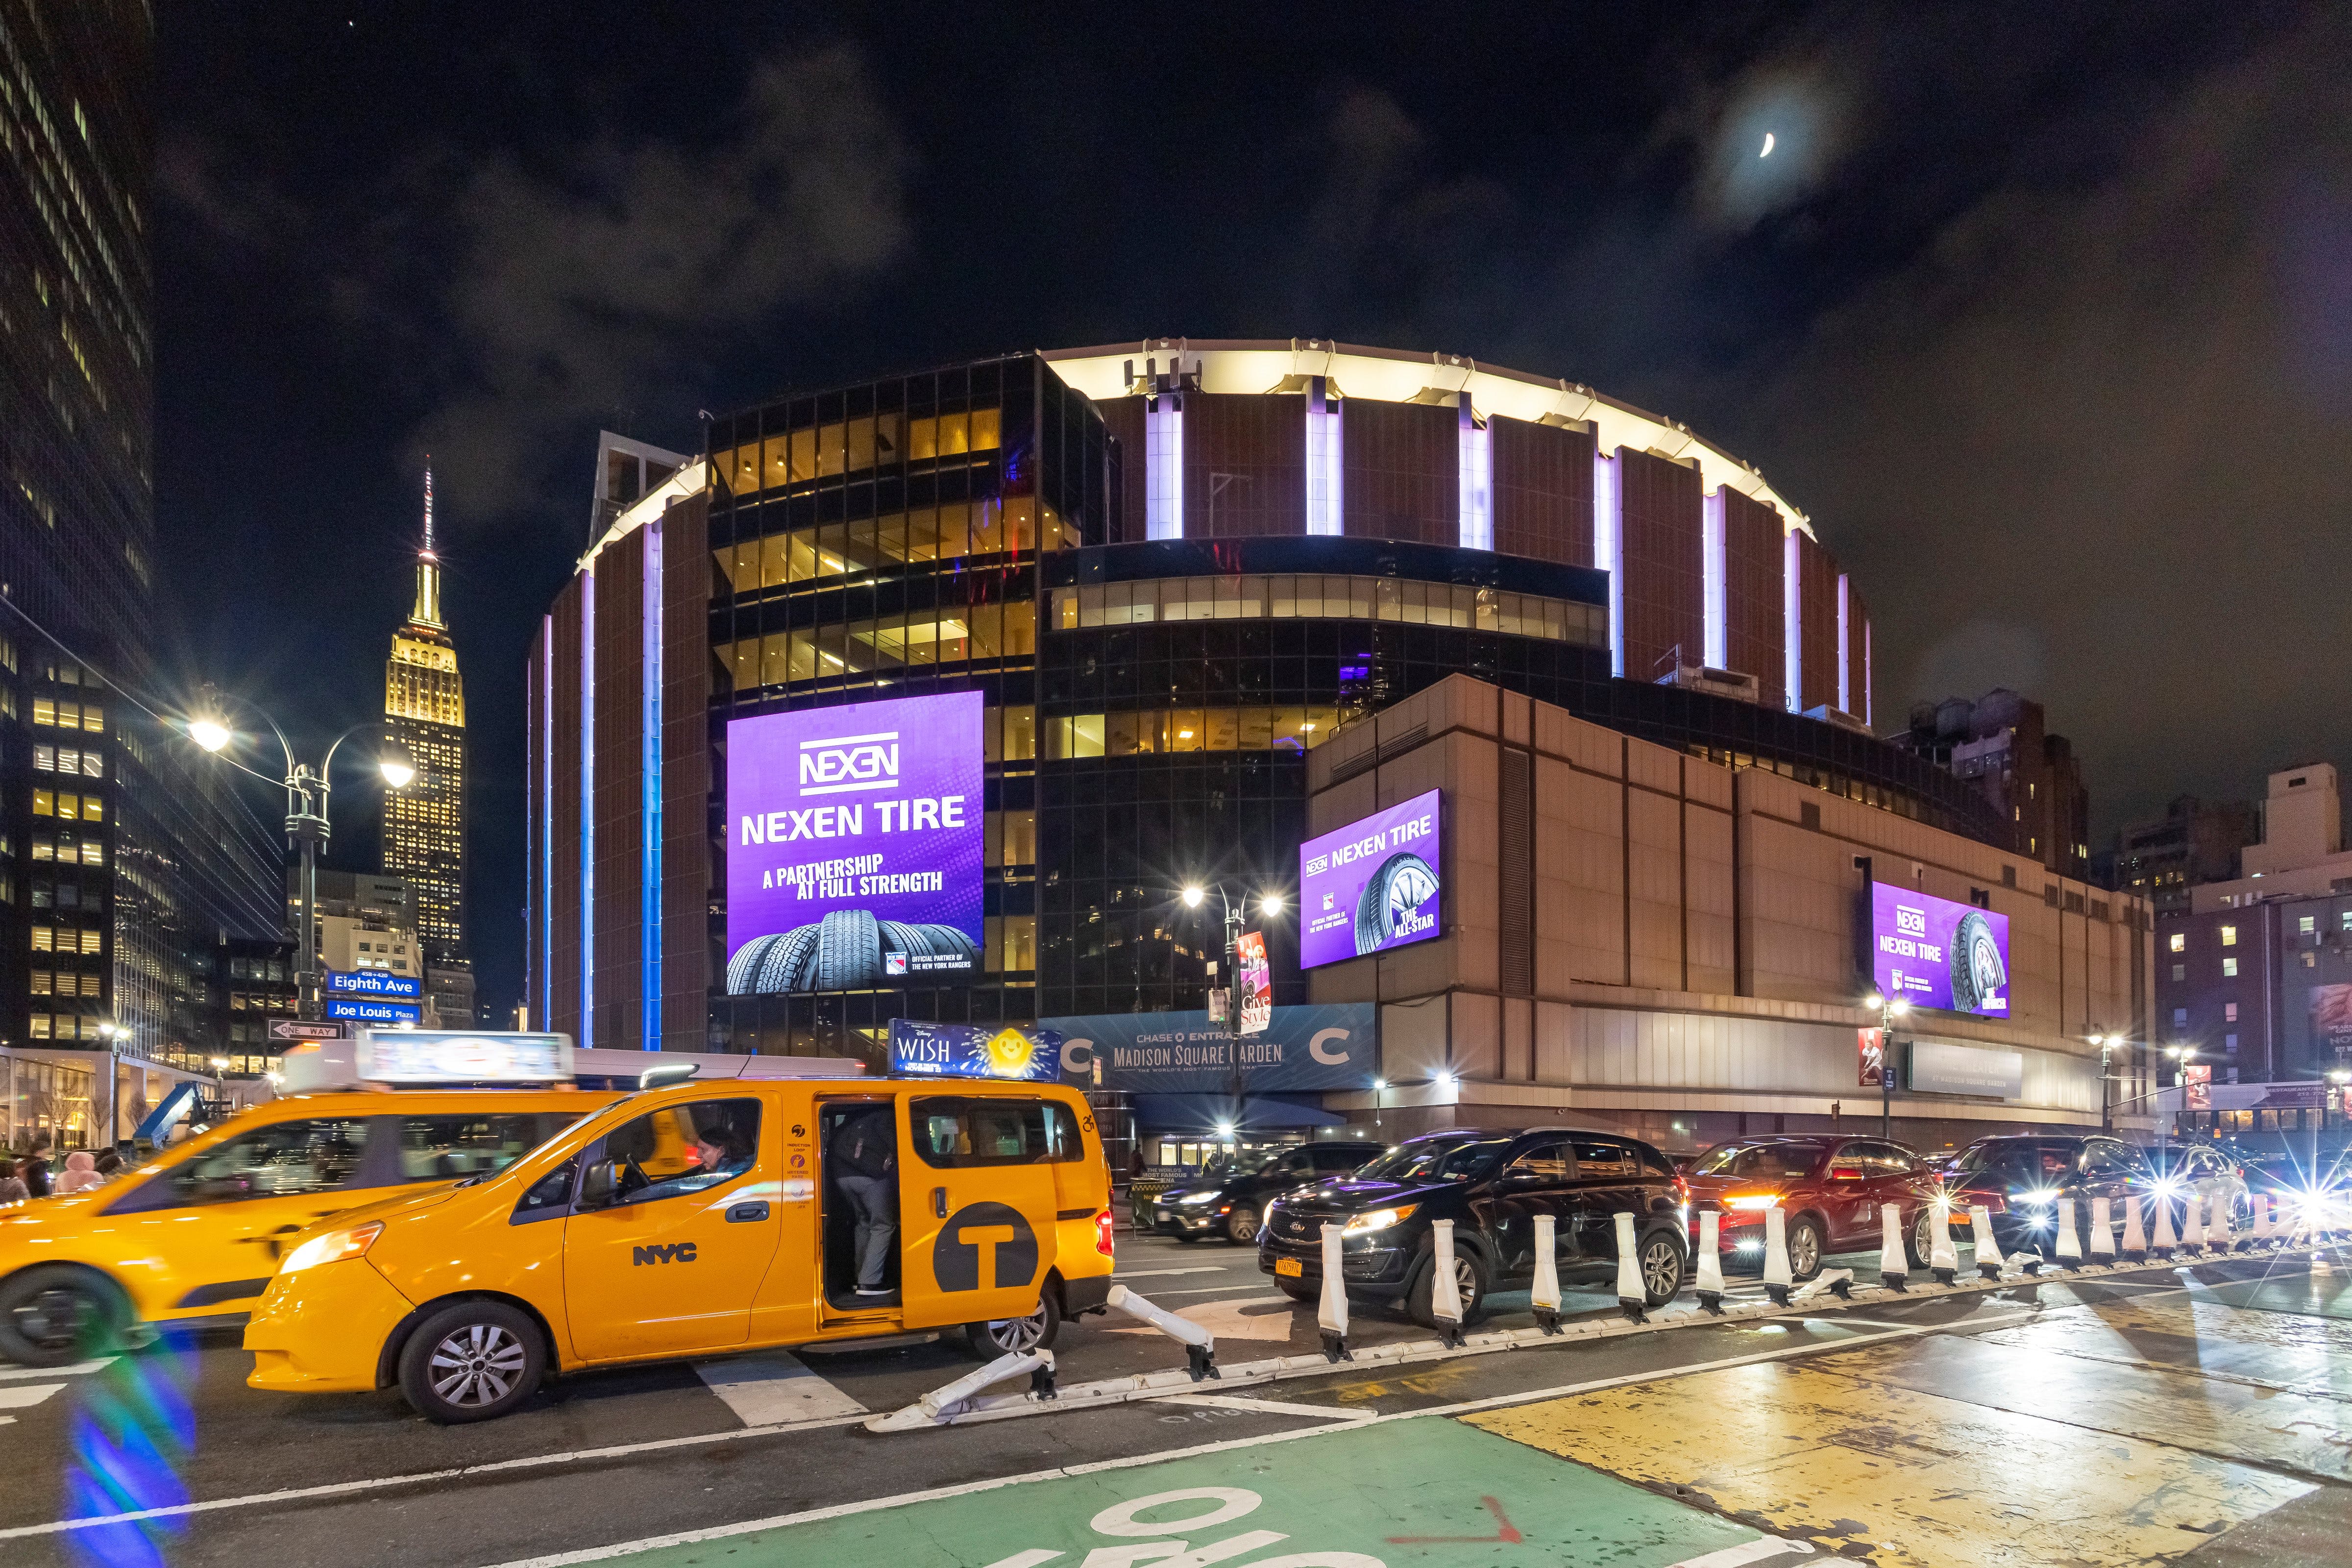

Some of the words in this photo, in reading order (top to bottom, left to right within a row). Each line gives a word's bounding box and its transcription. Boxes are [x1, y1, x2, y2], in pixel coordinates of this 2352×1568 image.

[800, 743, 899, 785] NEXEN
[741, 804, 862, 846] NEXEN
[874, 795, 965, 833] TIRE
[1332, 832, 1385, 868] NEXEN
[1390, 814, 1431, 846] TIRE
[762, 870, 773, 889] A
[777, 853, 883, 887] PARTNERSHIP
[1306, 857, 1328, 875] NEXEN
[1393, 856, 1414, 868] NEXEN
[797, 881, 815, 900] AT
[819, 878, 856, 899] FULL
[859, 871, 943, 896] STRENGTH
[1395, 913, 1434, 939] ALL-STAR
[1400, 906, 1418, 925] THE
[1897, 910, 1925, 932] NEXEN
[1880, 934, 1916, 958] NEXEN
[1917, 942, 1942, 963] TIRE
[335, 976, 381, 991] Eighth
[385, 981, 413, 992] Ave
[335, 1004, 356, 1016] Joe
[360, 1005, 392, 1018] Louis
[1242, 994, 1270, 1010] Give
[1241, 1009, 1270, 1027] Style
[915, 1029, 931, 1038] Disney
[1137, 1033, 1173, 1043] CHASE
[1189, 1031, 1260, 1041] ENTRACE
[897, 1037, 949, 1062] WISH
[1114, 1047, 1170, 1067] MADISON
[1175, 1045, 1225, 1066] SQUARE
[1309, 1028, 1350, 1065] C
[633, 1242, 697, 1266] NYC
[958, 1225, 1014, 1290] T
[1278, 1261, 1299, 1273] T767597C
